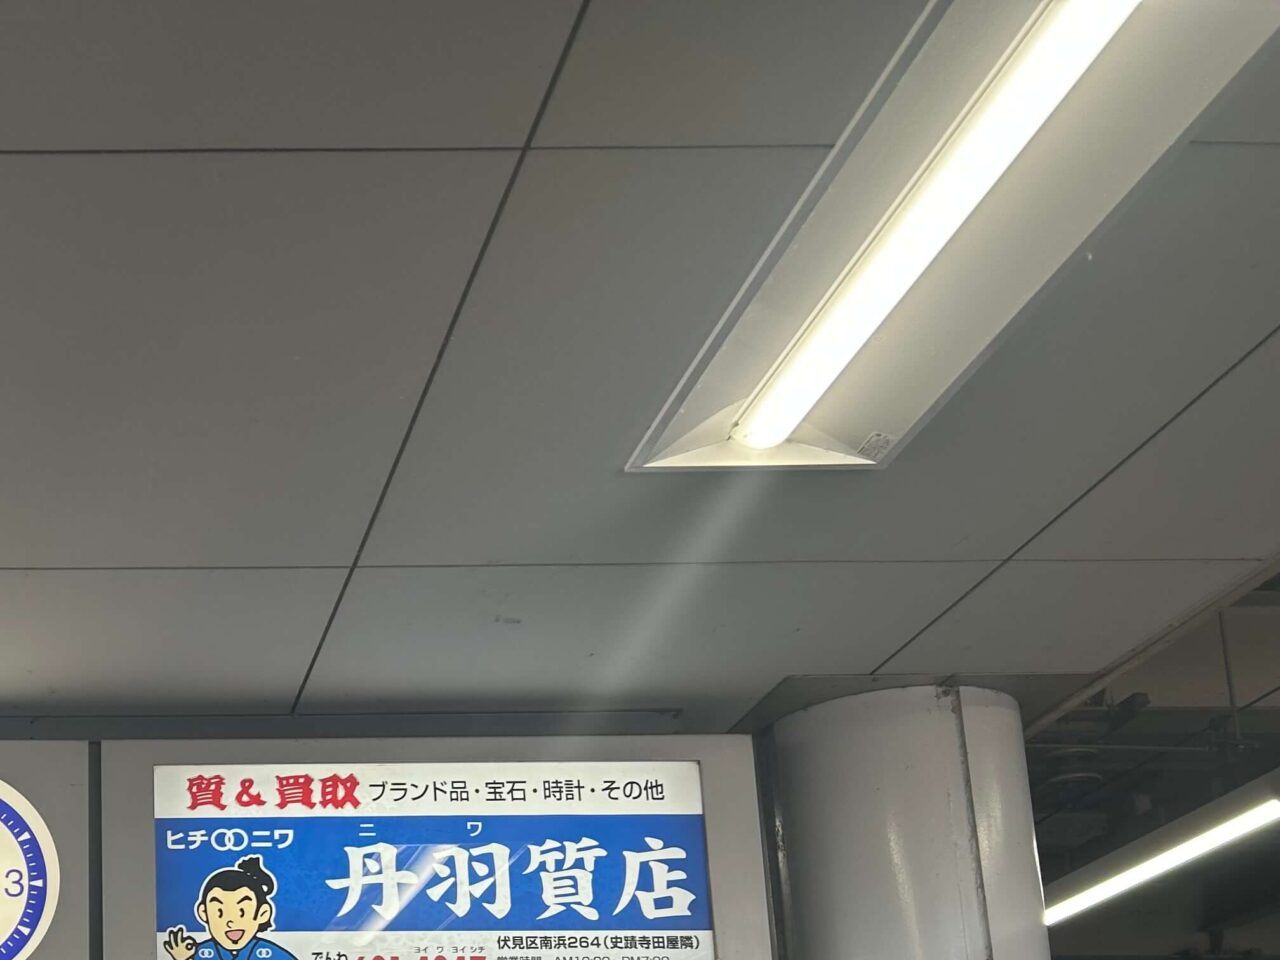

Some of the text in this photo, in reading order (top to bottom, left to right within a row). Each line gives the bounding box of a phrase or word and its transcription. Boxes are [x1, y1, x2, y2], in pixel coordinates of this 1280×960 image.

[369, 779, 665, 802] ブランド品・宝石・時計・その他
[4, 869, 24, 897] 3
[325, 836, 697, 921] 丹羽質店
